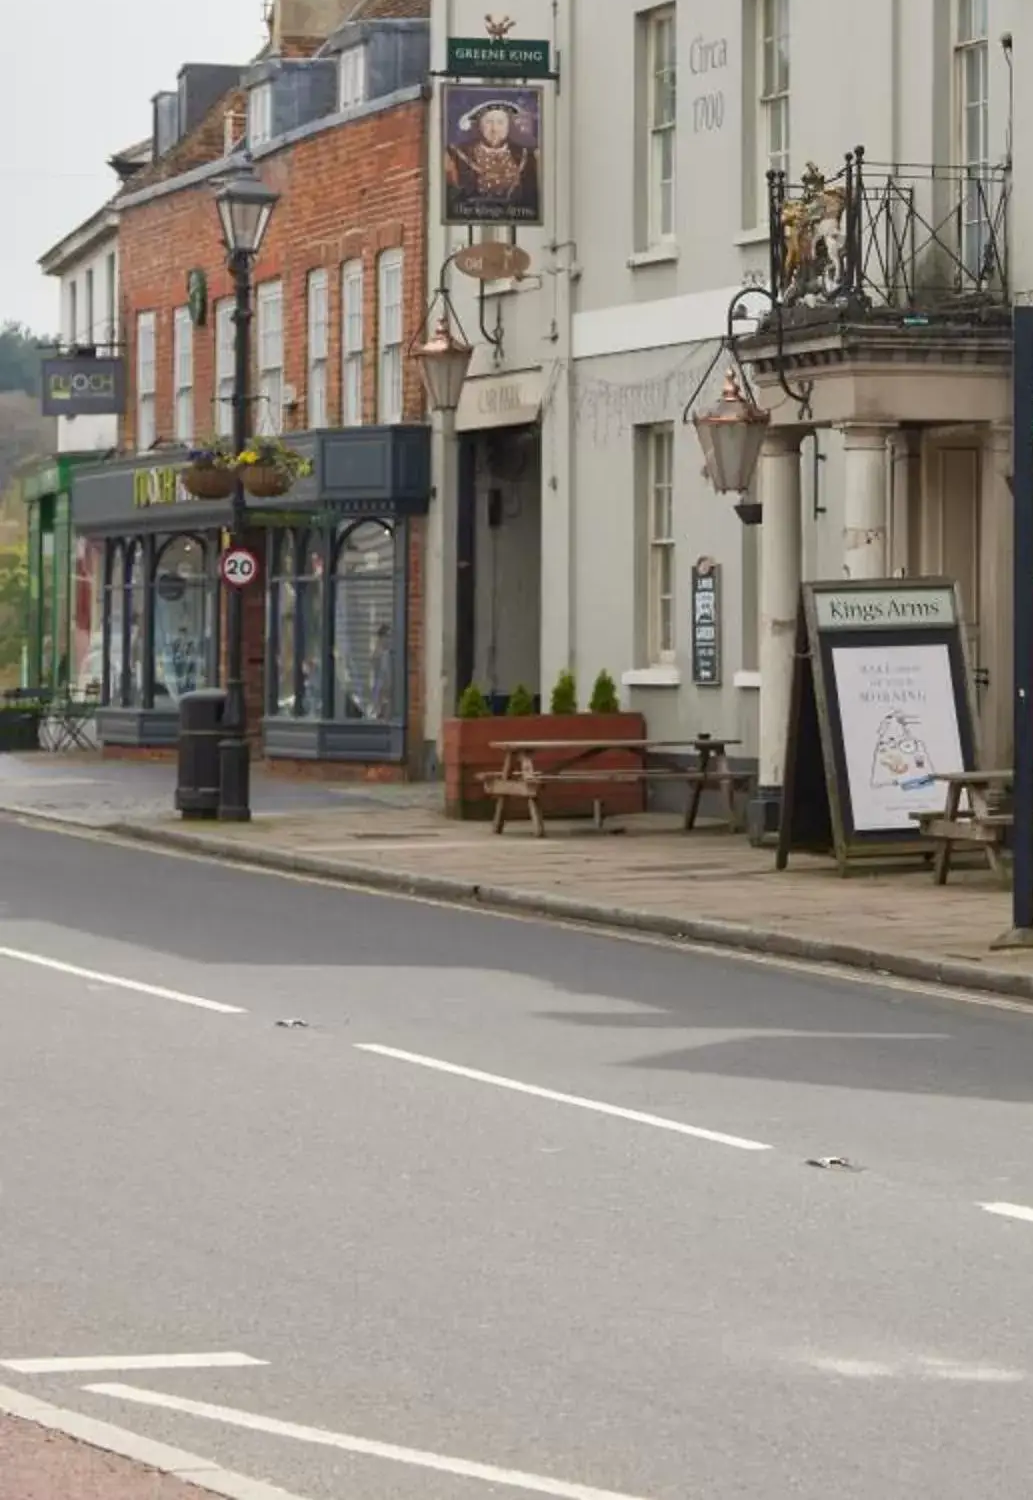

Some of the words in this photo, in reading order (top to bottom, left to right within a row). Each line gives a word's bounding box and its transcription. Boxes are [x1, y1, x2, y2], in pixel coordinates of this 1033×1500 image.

[455, 48, 505, 61] GREENE
[509, 49, 543, 62] KING
[689, 33, 728, 75] Circa
[692, 91, 725, 133] 1700
[227, 559, 253, 577] 20
[829, 600, 883, 622] Kings
[887, 598, 940, 618] Arms
